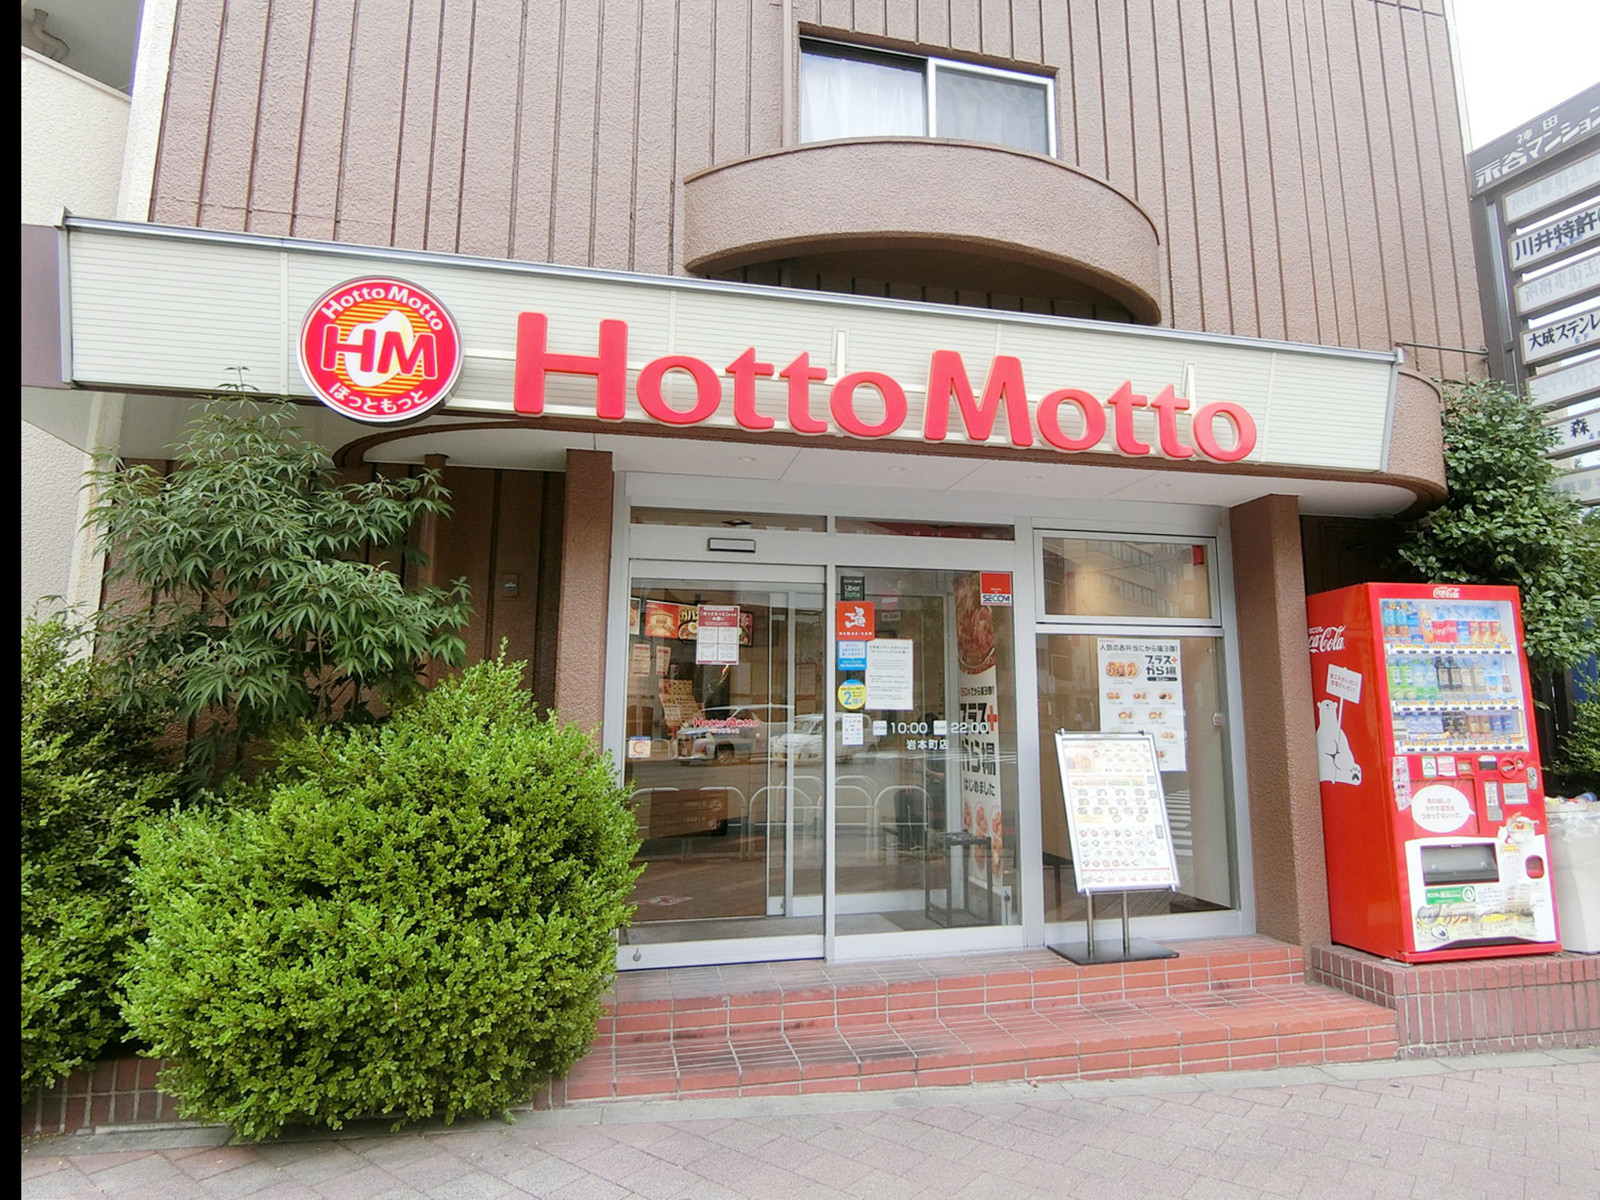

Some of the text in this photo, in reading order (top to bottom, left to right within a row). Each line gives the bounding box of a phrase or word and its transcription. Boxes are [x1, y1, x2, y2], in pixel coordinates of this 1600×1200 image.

[1515, 206, 1600, 261] 川井特許
[320, 324, 438, 380] HM
[329, 382, 428, 413] ほっともっと
[1570, 418, 1590, 438] 森
[982, 594, 1010, 602] SECOM
[890, 722, 928, 734] 10:00
[950, 722, 989, 734] 22:00
[906, 738, 949, 750] 岩本町店
[964, 777, 995, 797] はじめました
